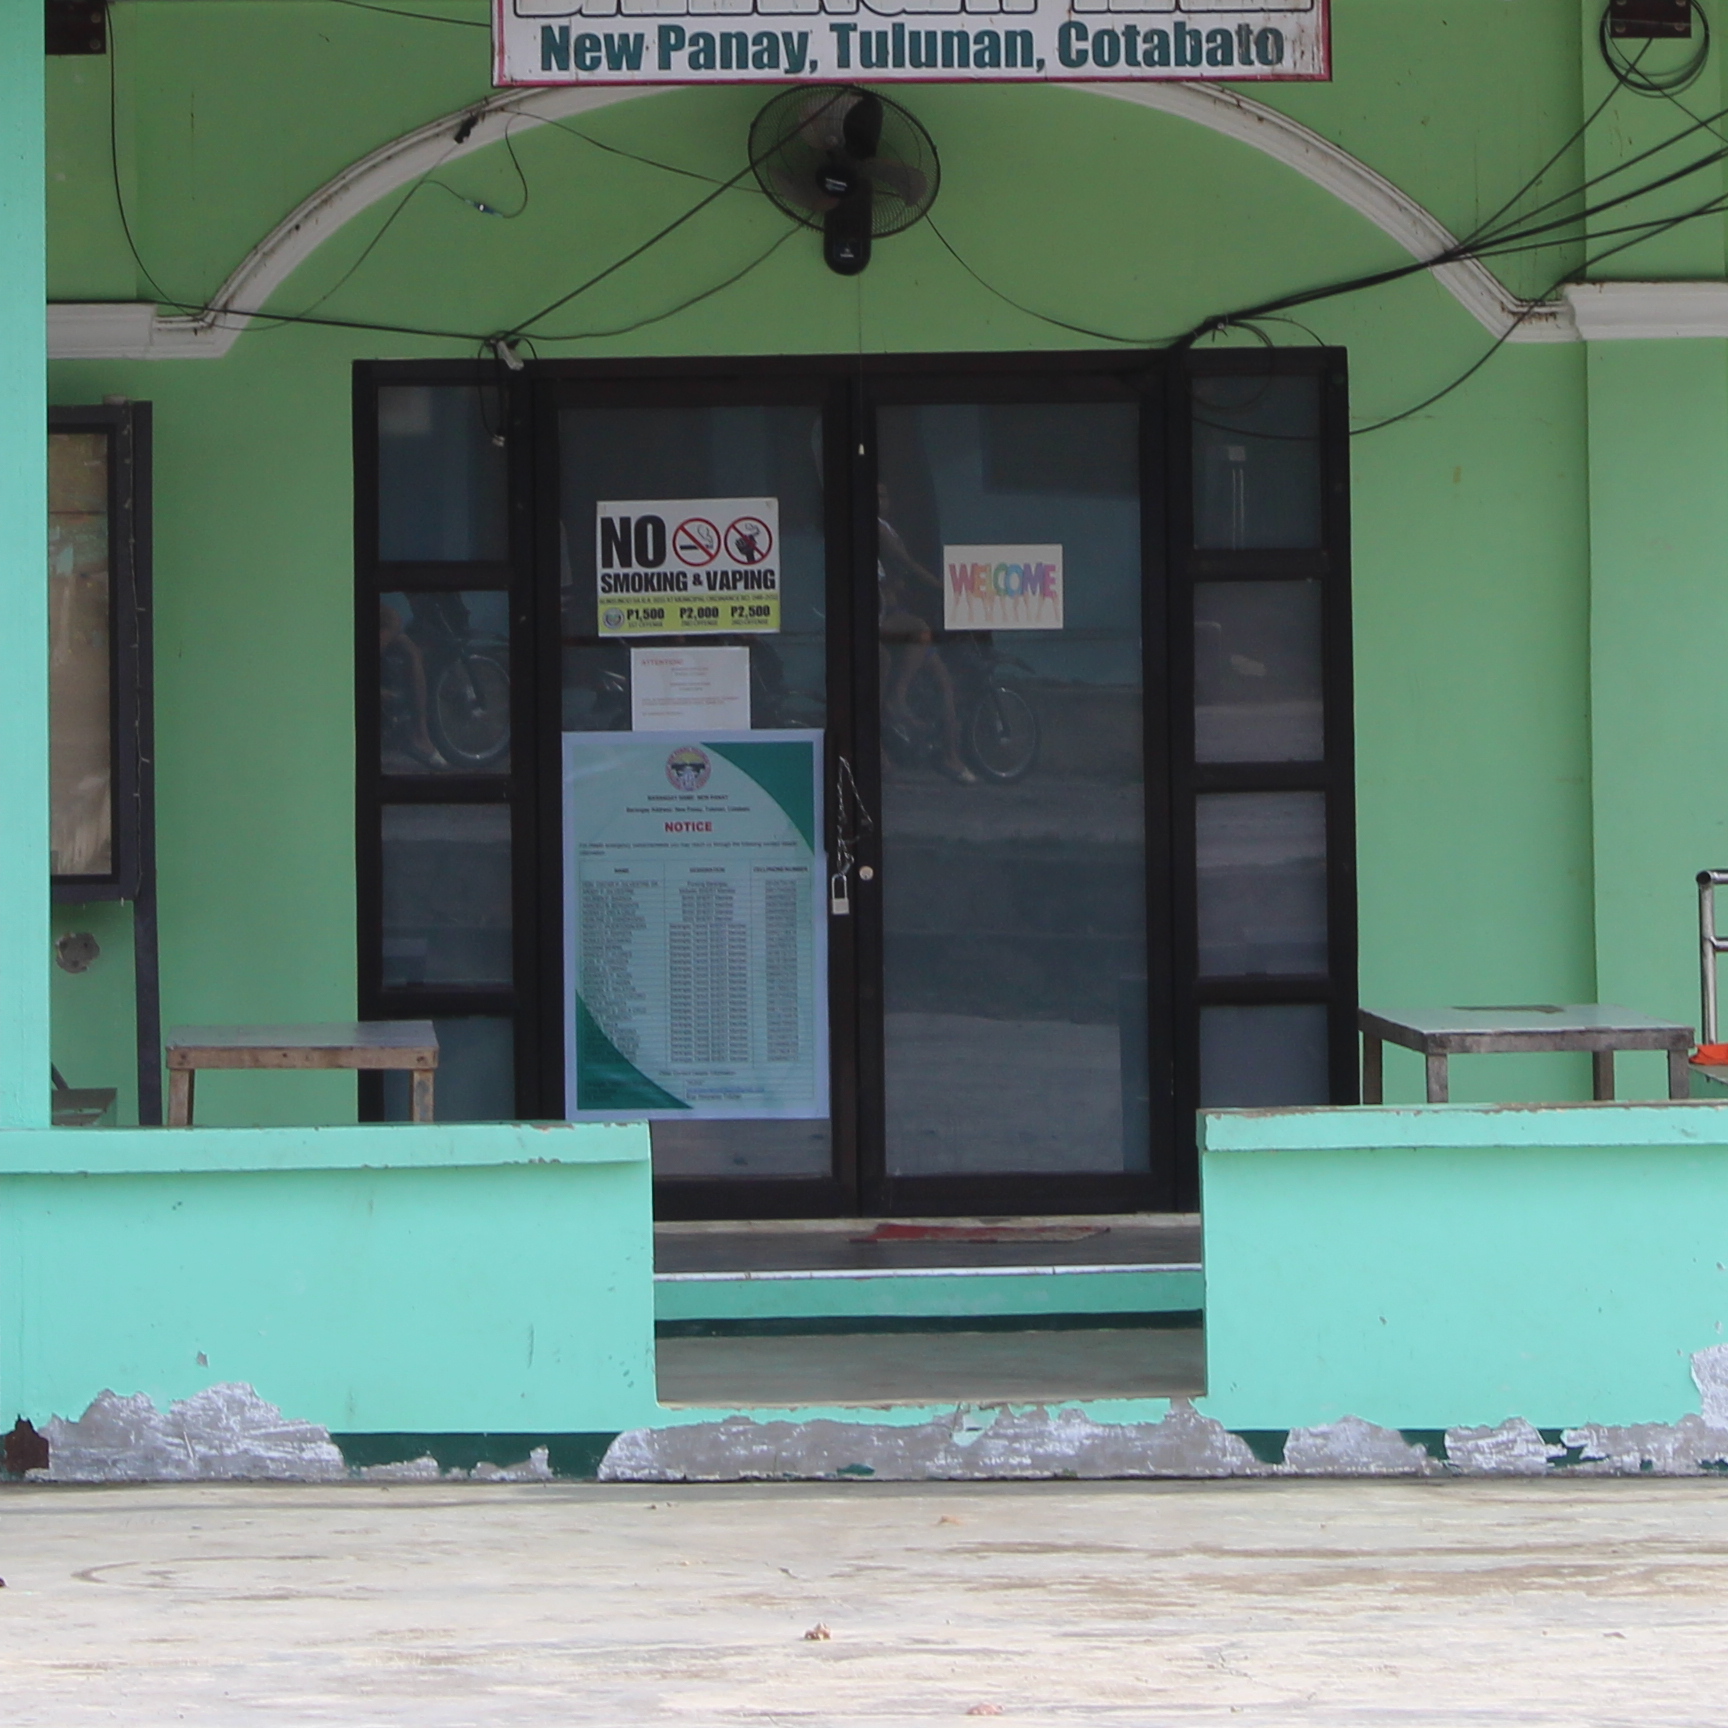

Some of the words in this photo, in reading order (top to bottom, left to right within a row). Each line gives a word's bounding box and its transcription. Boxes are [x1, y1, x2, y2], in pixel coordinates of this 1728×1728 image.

[540, 23, 645, 71] New
[657, 23, 818, 74] Panay,
[829, 22, 1046, 72] Tulunan,
[1058, 21, 1286, 68] Cotabato
[600, 515, 666, 569] NO
[600, 571, 688, 594] SMOKING
[692, 573, 704, 587] &
[706, 569, 776, 591] VAPING
[949, 562, 1056, 599] WELCOME
[627, 607, 665, 622] P1,500
[680, 606, 719, 621] P2,000
[731, 604, 770, 619] P2,500
[665, 821, 713, 832] NOTICE
